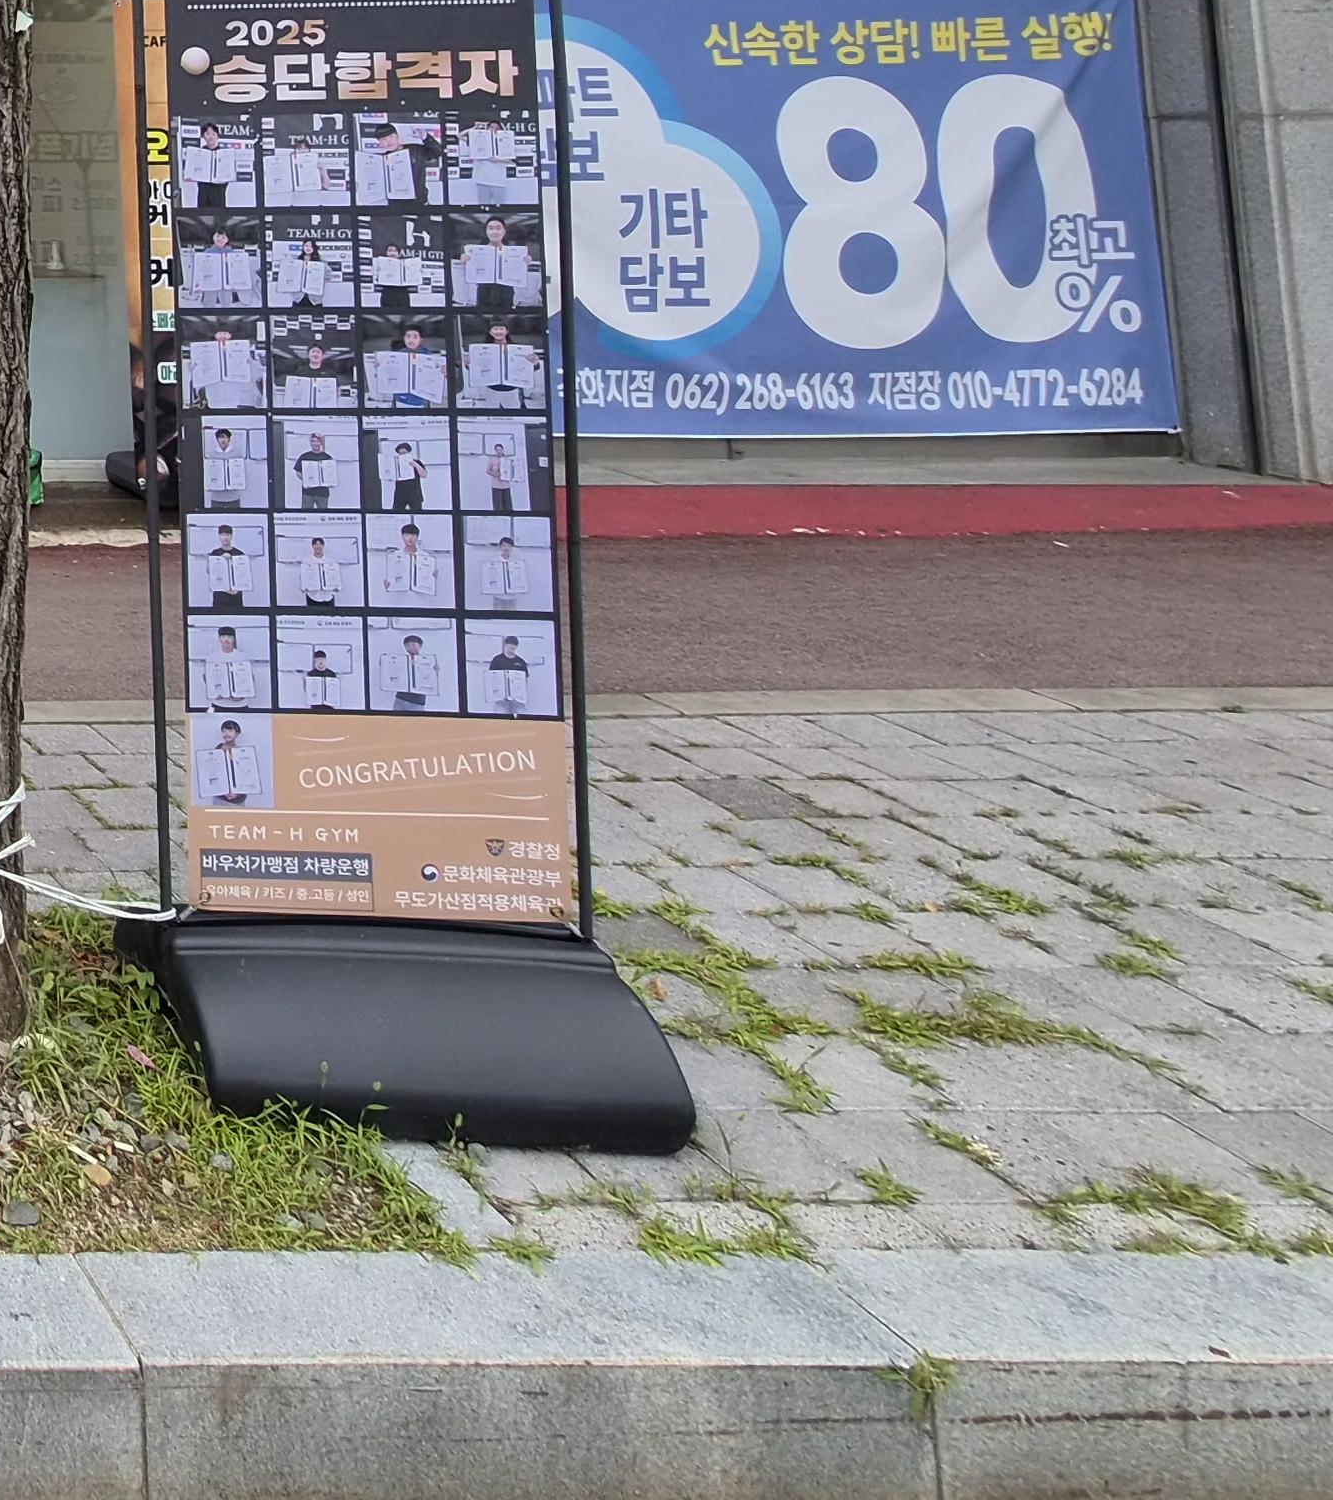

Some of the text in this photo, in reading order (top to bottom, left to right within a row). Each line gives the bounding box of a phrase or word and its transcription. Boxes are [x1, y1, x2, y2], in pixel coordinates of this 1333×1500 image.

[225, 18, 328, 48] 2025
[703, 11, 1114, 68] 신속한 상담! 빠른 실행!
[212, 49, 520, 104] 승단합격자
[618, 187, 710, 251] 기타
[776, 73, 1100, 351] 80
[1048, 213, 1136, 268] 최고
[618, 255, 712, 314] 담보
[867, 369, 942, 411] 지점장
[947, 367, 1145, 410] 010-4772-6284
[298, 748, 537, 791] CONGRATULATION
[315, 827, 360, 844] GYM
[508, 839, 561, 861] 경찰청
[202, 854, 370, 878] 바우처가맹점 차량운행
[442, 864, 563, 889] 문화체육관광부
[262, 887, 286, 900] 키즈
[346, 889, 370, 903] 성인
